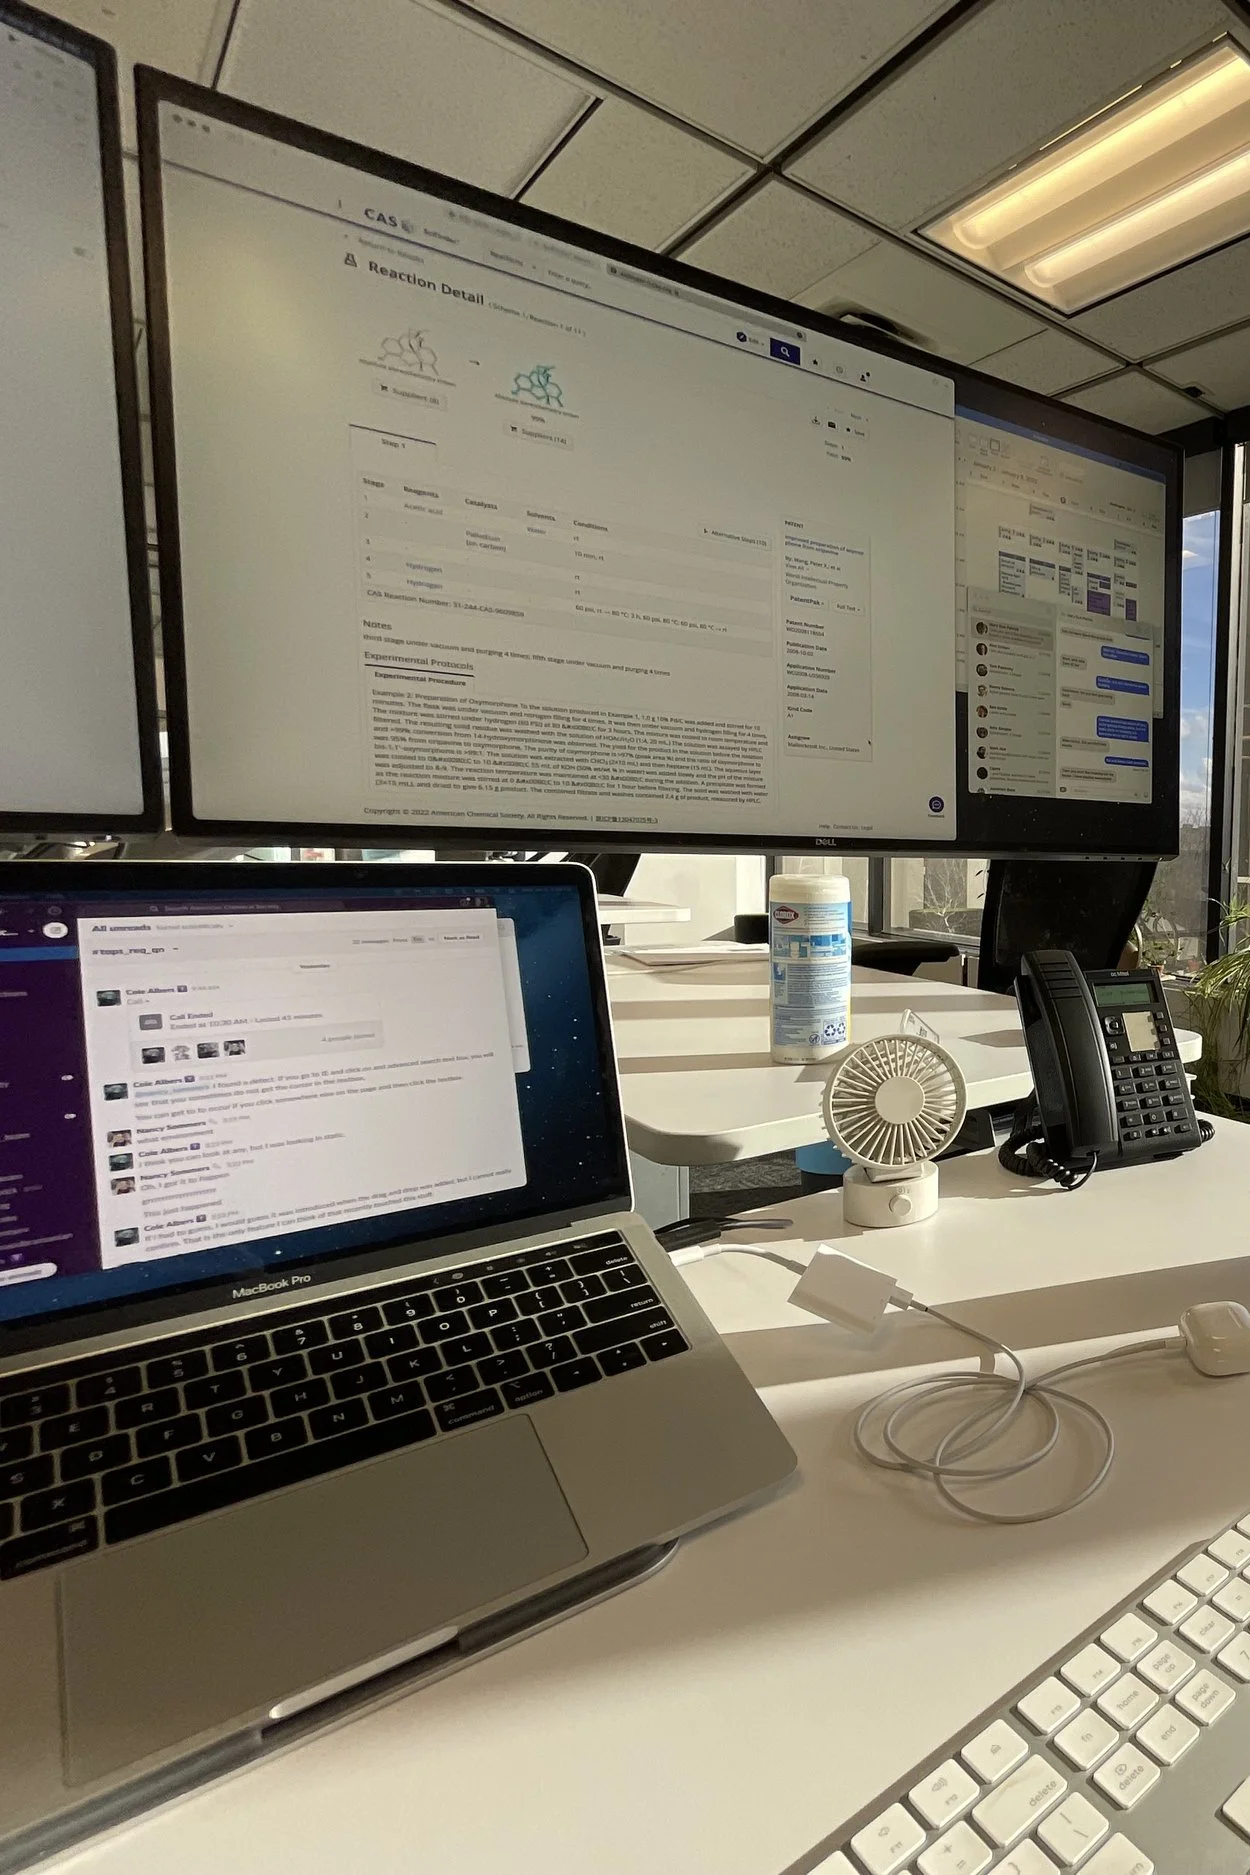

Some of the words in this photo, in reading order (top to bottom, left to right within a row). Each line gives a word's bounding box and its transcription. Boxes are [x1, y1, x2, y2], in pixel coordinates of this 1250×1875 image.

[364, 207, 398, 228] CAS
[368, 260, 437, 292] Reaction
[441, 282, 484, 305] Detail
[362, 476, 385, 489] Stage
[403, 485, 439, 499] Reagents
[464, 498, 498, 511] Catalysts
[526, 509, 556, 522] Solvents
[573, 520, 608, 532] Conditions
[405, 561, 443, 574] Hydrogen
[366, 589, 382, 598] CAS
[384, 591, 417, 603] Reaction
[789, 594, 821, 606] PatentPak
[363, 618, 393, 631] Notes
[786, 619, 803, 627] Patent
[804, 622, 825, 630] Number
[363, 633, 383, 642] third
[384, 636, 405, 646] stage
[406, 639, 429, 648] under
[430, 642, 459, 652] vacuum
[461, 645, 475, 653] and
[475, 648, 504, 659] purging
[786, 640, 815, 650] Publication
[364, 650, 429, 666] Experimental
[431, 657, 474, 671] Protocols
[787, 662, 816, 671] Application
[374, 671, 427, 683] Experimental
[428, 677, 467, 687] Procedure
[787, 684, 816, 692] Application
[372, 688, 405, 700] Example
[415, 693, 458, 704] Preparation
[364, 806, 400, 817] Copyright
[431, 809, 465, 818] American
[467, 811, 499, 819] Chemical
[537, 813, 556, 822] Rights
[815, 838, 837, 846] DELL
[92, 924, 107, 933] All
[109, 923, 151, 932] unreads
[170, 1013, 186, 1021] Call
[187, 1011, 214, 1020] Ended
[171, 1021, 197, 1031] Ended
[133, 1079, 154, 1089] Cole
[154, 1077, 183, 1086] Albers
[136, 1126, 165, 1135] Nancy
[166, 1120, 207, 1131] Sommers
[138, 1150, 159, 1158] Cole
[160, 1145, 188, 1155] Albers
[140, 1172, 169, 1182] Nancy
[170, 1165, 210, 1177] Sommers
[144, 1223, 165, 1232] Cole
[166, 1218, 194, 1229] Albers
[605, 1255, 628, 1266] delete
[232, 1278, 289, 1299] MacBook
[291, 1274, 311, 1285] Pro
[456, 1295, 466, 1304] 0
[630, 1298, 654, 1310] return
[405, 1309, 416, 1317] 9
[489, 1309, 498, 1317] P
[353, 1322, 363, 1331] 8
[439, 1322, 450, 1331] O
[649, 1319, 668, 1330] shift
[463, 1344, 472, 1352] L
[236, 1353, 247, 1361] 6
[332, 1351, 343, 1360] U
[409, 1358, 420, 1368] K
[173, 1369, 184, 1378] 5
[272, 1367, 282, 1377] Y
[355, 1375, 364, 1384] J
[104, 1386, 116, 1395] 4
[210, 1384, 220, 1394] T
[295, 1391, 307, 1402] H
[391, 1393, 404, 1405] M
[514, 1389, 543, 1403] option
[141, 1402, 153, 1412] R
[231, 1410, 243, 1420] G
[333, 1412, 344, 1423] N
[448, 1405, 495, 1424] command
[69, 1422, 81, 1433] E
[163, 1430, 174, 1440] F
[270, 1432, 281, 1442] B
[88, 1451, 103, 1462] D
[203, 1451, 215, 1463] V
[10, 1472, 24, 1484] S
[131, 1474, 144, 1486] C
[52, 1498, 65, 1510] X
[1239, 1650, 1250, 1661] 7
[1152, 1653, 1171, 1671] page
[1165, 1663, 1176, 1674] up
[1192, 1682, 1210, 1702] page
[1116, 1689, 1140, 1711] home
[1200, 1689, 1220, 1709] down
[1081, 1731, 1094, 1744] fn
[1160, 1724, 1178, 1742] end
[1118, 1764, 1145, 1791] delete
[1028, 1780, 1057, 1808] delete
